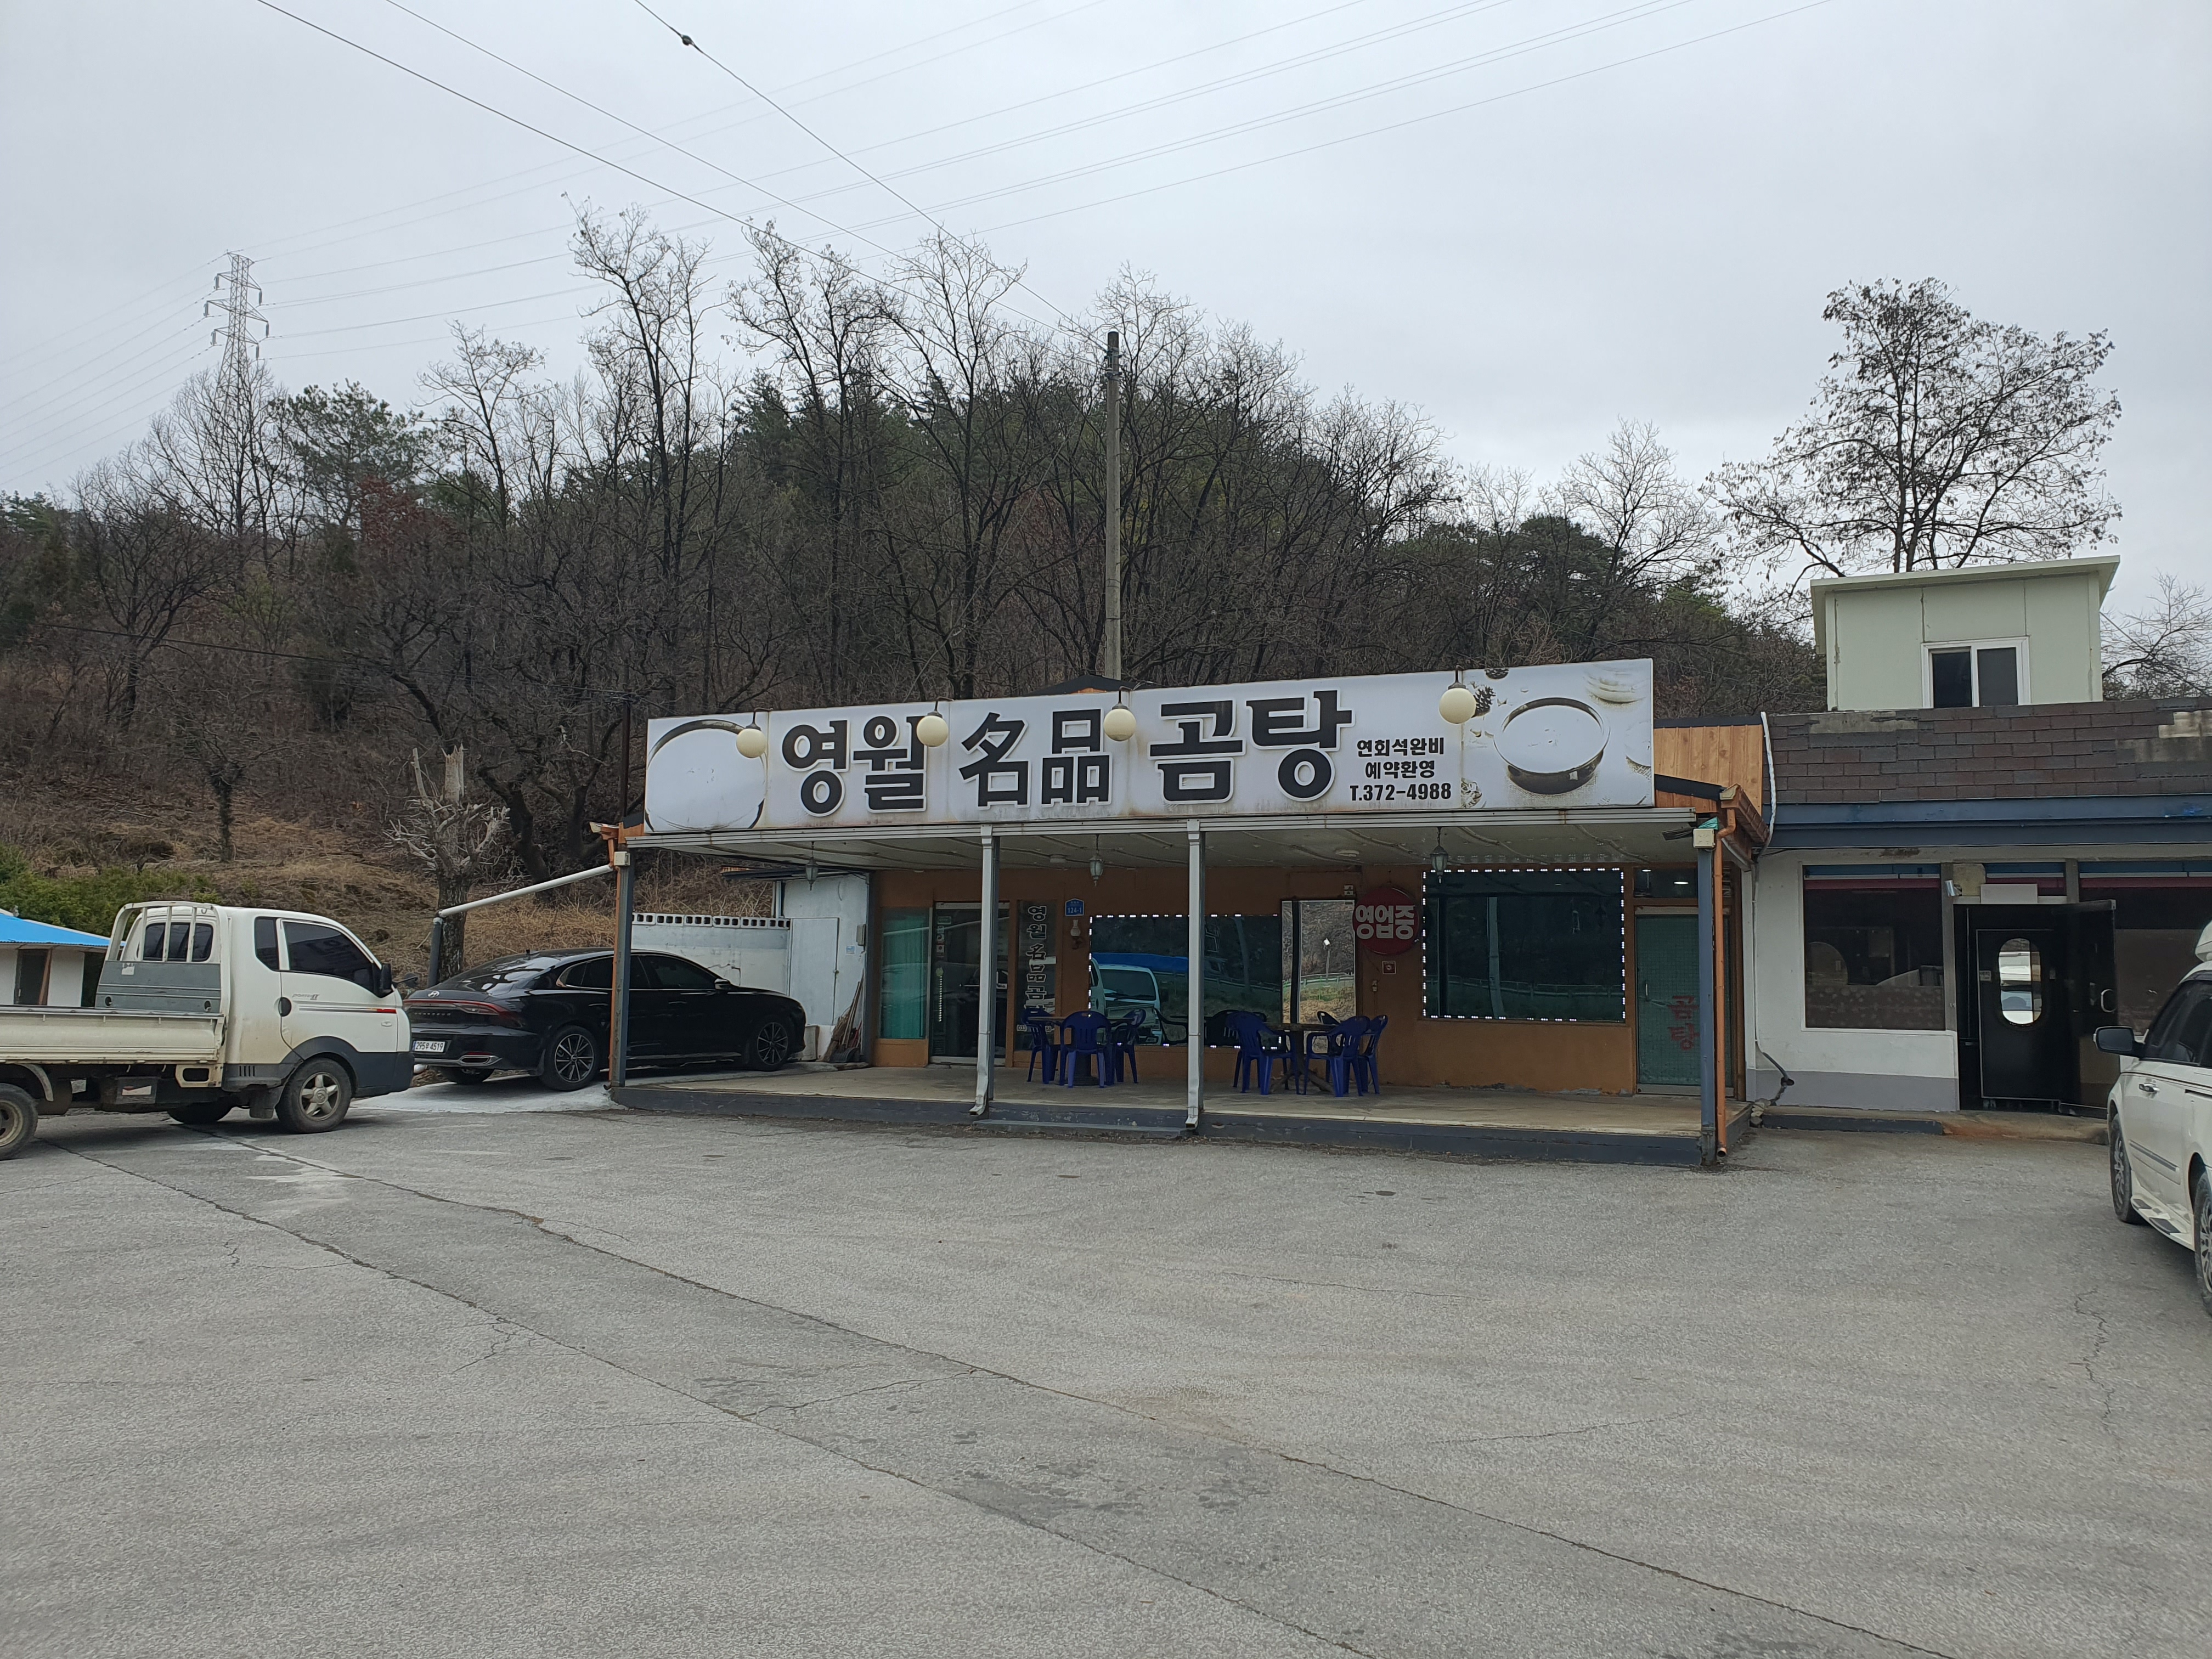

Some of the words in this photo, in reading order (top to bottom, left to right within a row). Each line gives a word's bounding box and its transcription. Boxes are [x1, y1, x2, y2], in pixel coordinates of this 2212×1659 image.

[781, 715, 928, 814] 영월
[958, 709, 1110, 807] 名品
[1148, 690, 1353, 800] 곰탕
[1357, 737, 1444, 757] 연회석완비
[1365, 760, 1435, 780] 예약환영
[1350, 783, 1452, 801] T.372-4988
[1026, 906, 1047, 940] 영월
[1355, 905, 1415, 940] 영업중
[1025, 943, 1046, 983] 名品
[1667, 996, 1700, 1050] 곰탕
[430, 1042, 444, 1051] 4519
